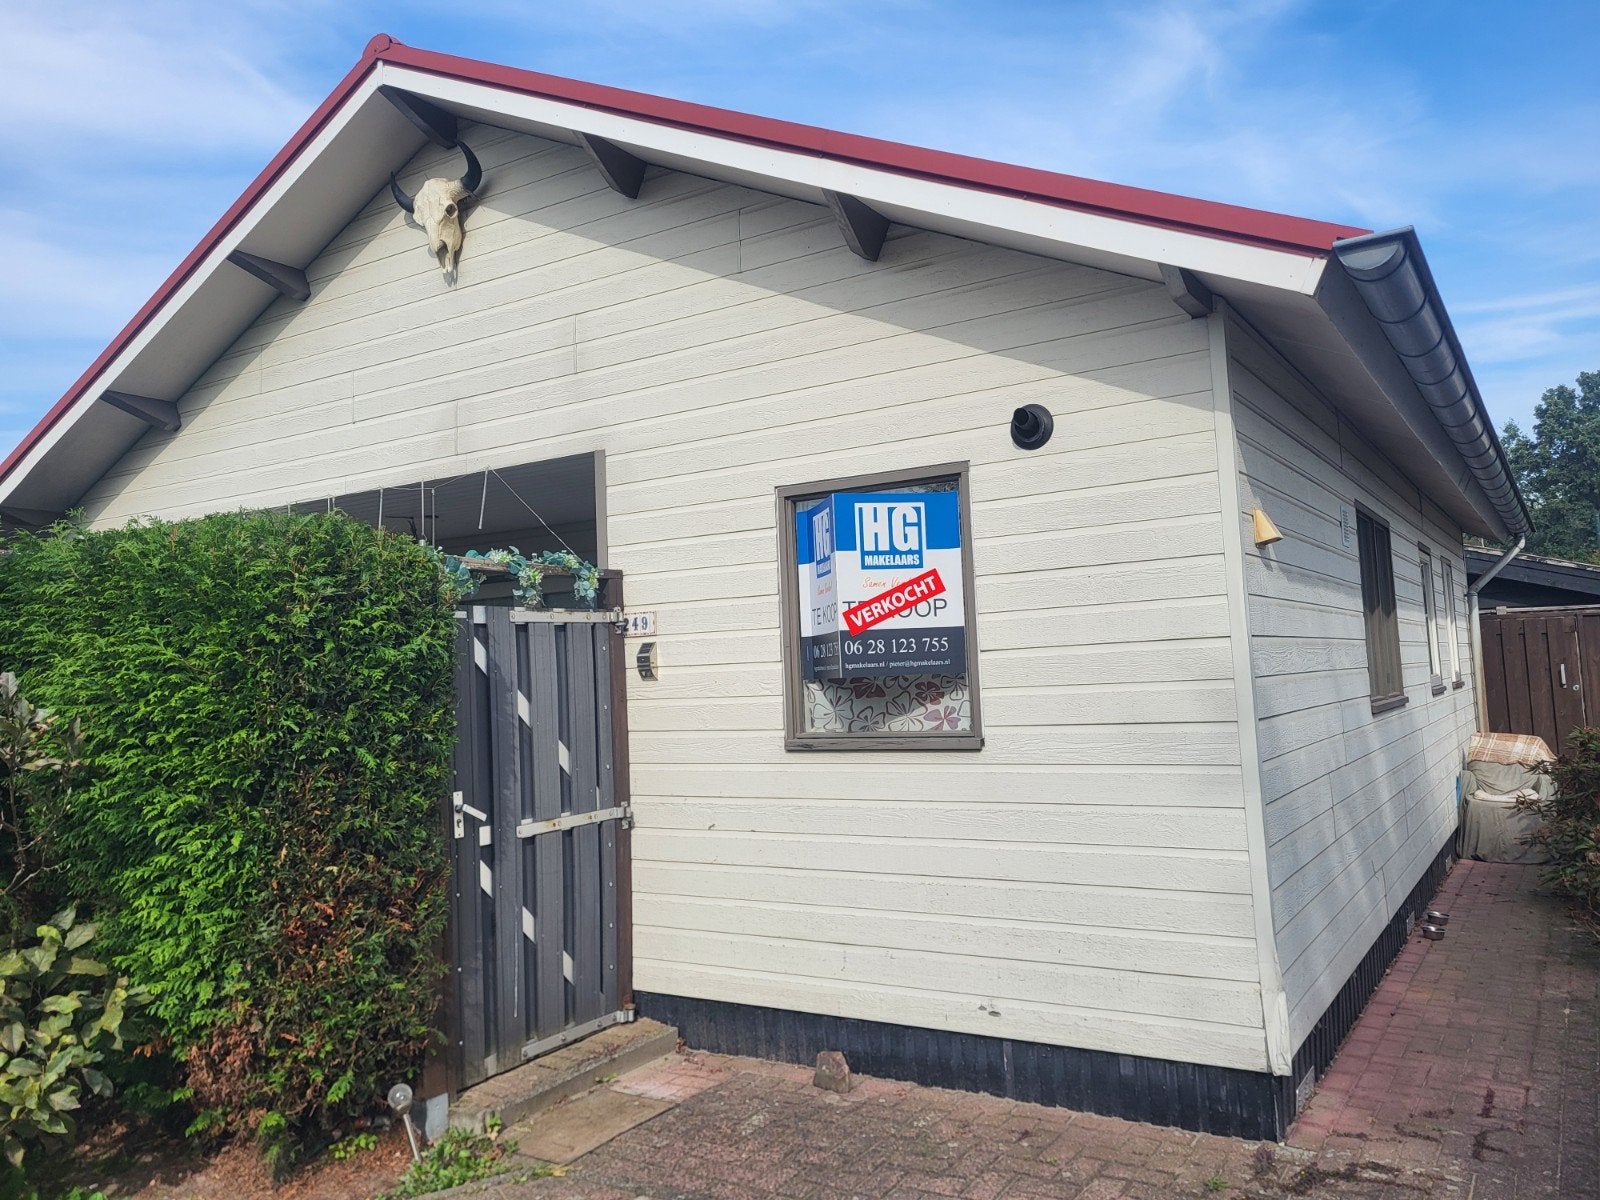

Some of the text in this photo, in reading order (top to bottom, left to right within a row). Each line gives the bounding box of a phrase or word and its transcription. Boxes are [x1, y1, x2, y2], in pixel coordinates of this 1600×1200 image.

[863, 505, 920, 551] HG
[864, 554, 920, 566] MAKELAARS
[862, 577, 887, 589] Samen
[849, 575, 936, 628] VERKOCHT
[892, 599, 948, 618] OP
[812, 607, 822, 626] TE
[844, 640, 863, 655] 06
[867, 639, 886, 655] 28
[891, 638, 917, 654] 123
[922, 637, 949, 652] 755
[844, 661, 885, 671] hgmakelaars.nl
